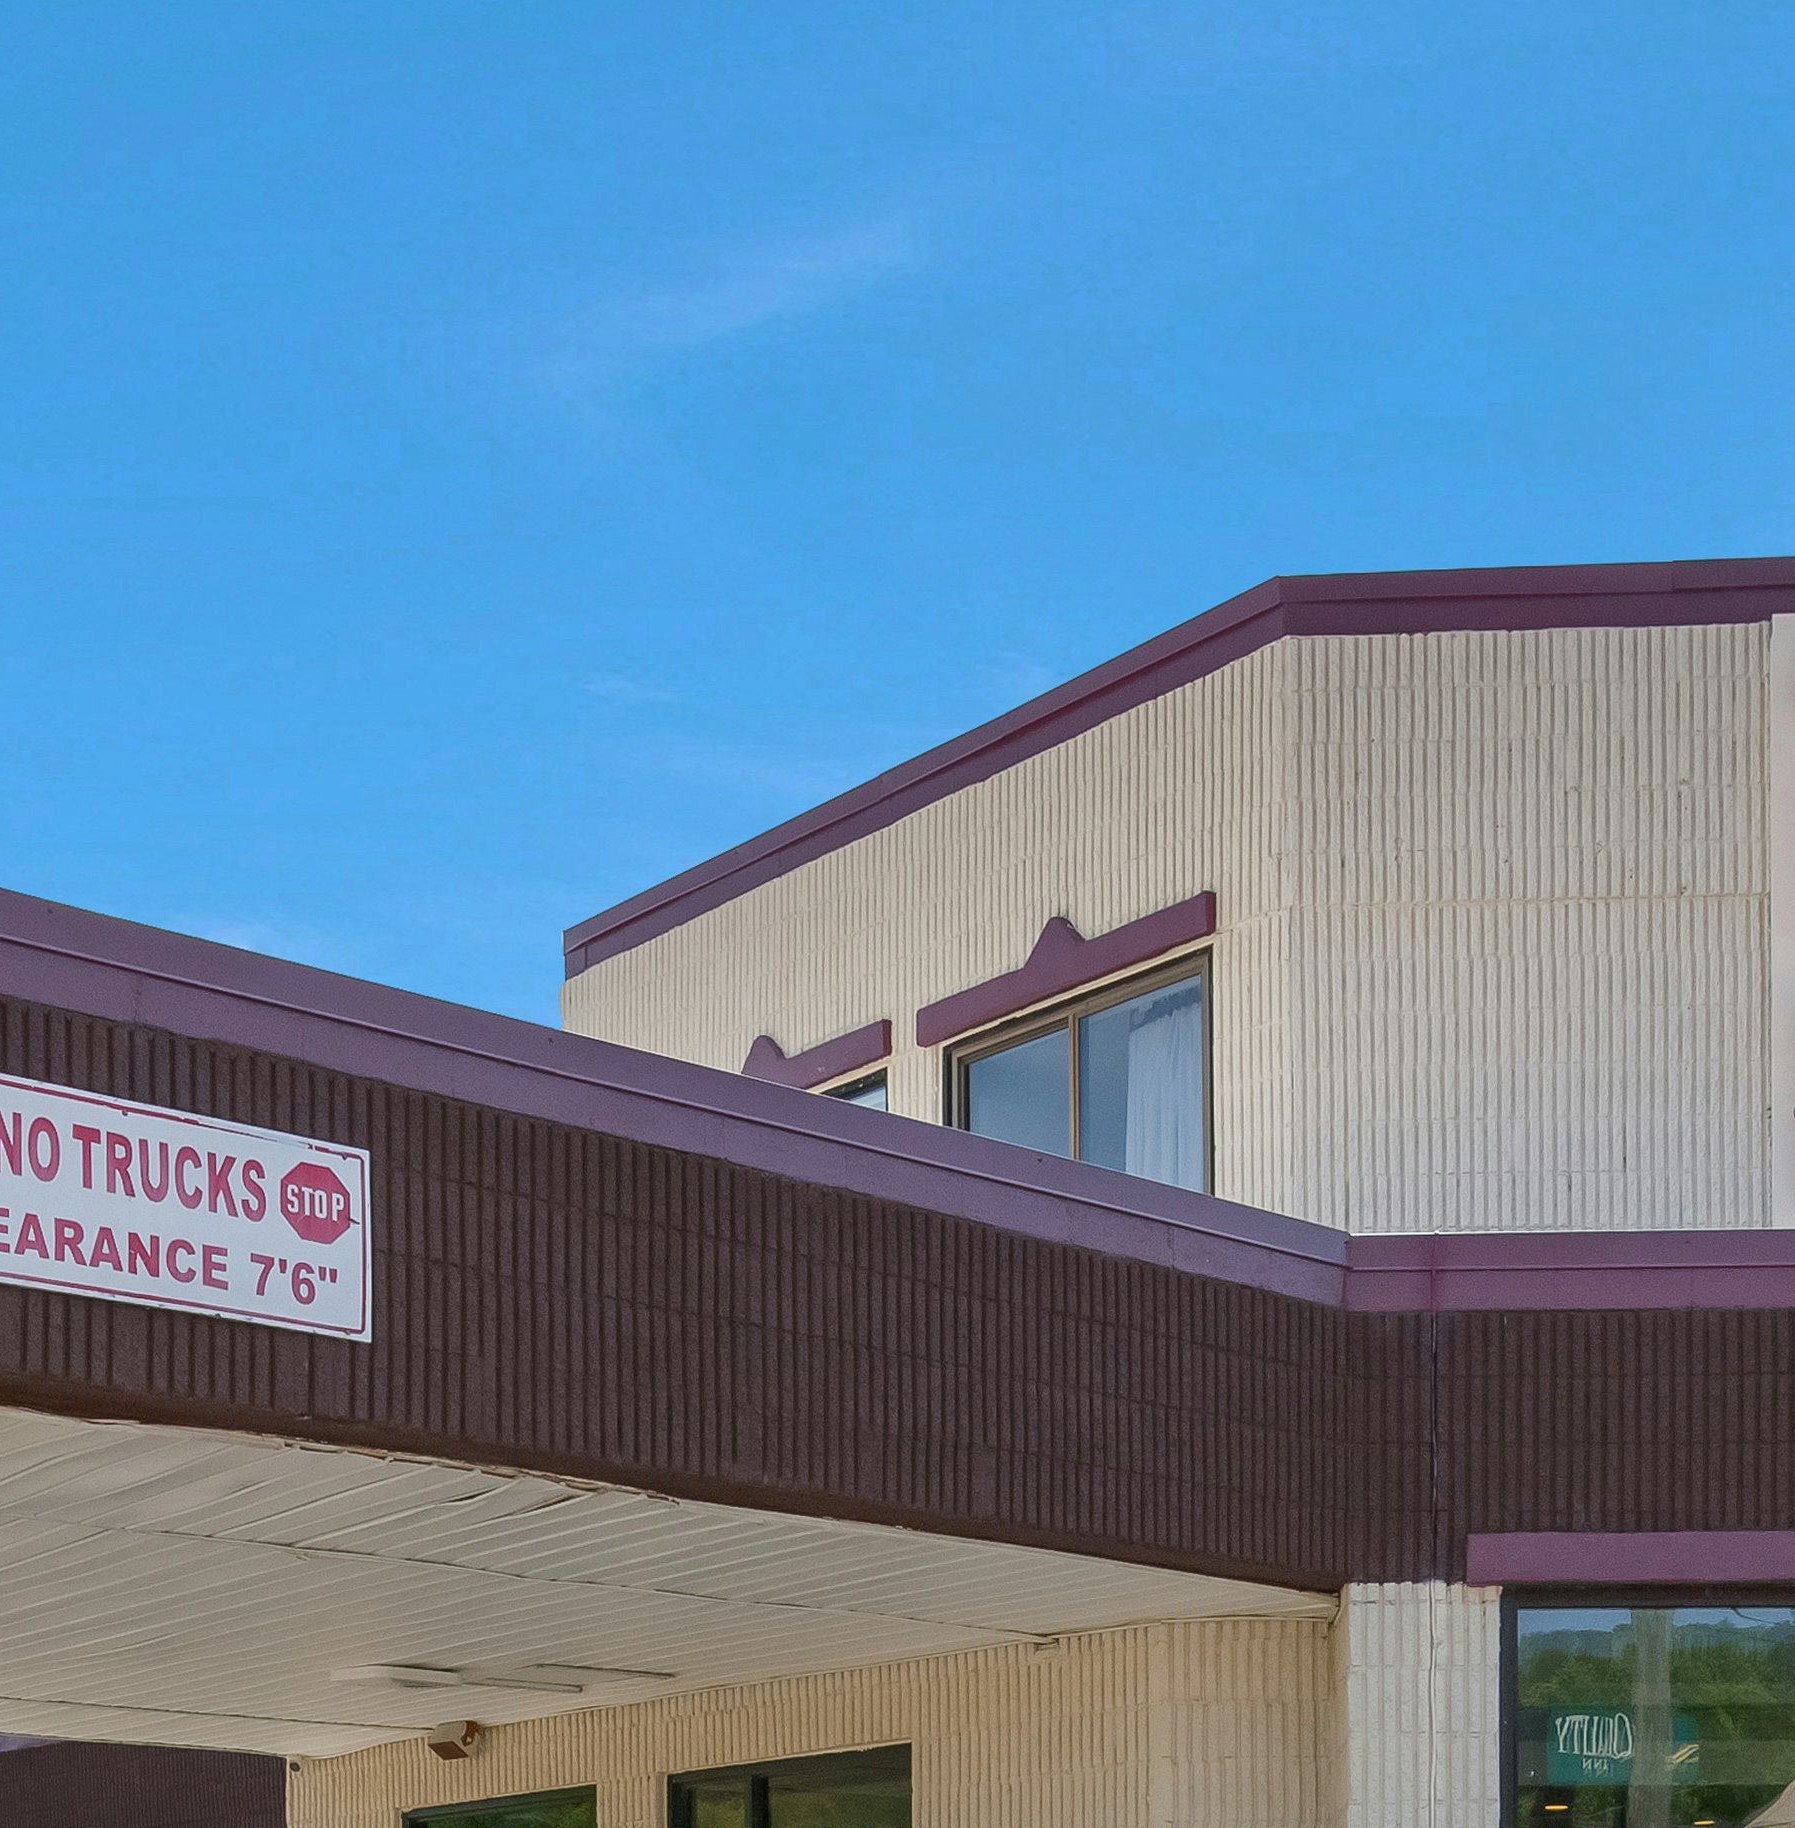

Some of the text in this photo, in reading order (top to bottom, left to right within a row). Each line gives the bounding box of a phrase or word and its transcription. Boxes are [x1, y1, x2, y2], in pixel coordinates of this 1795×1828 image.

[72, 1124, 267, 1223] TRUCKS
[286, 1184, 345, 1222] STOP
[249, 1252, 338, 1305] 7'6"
